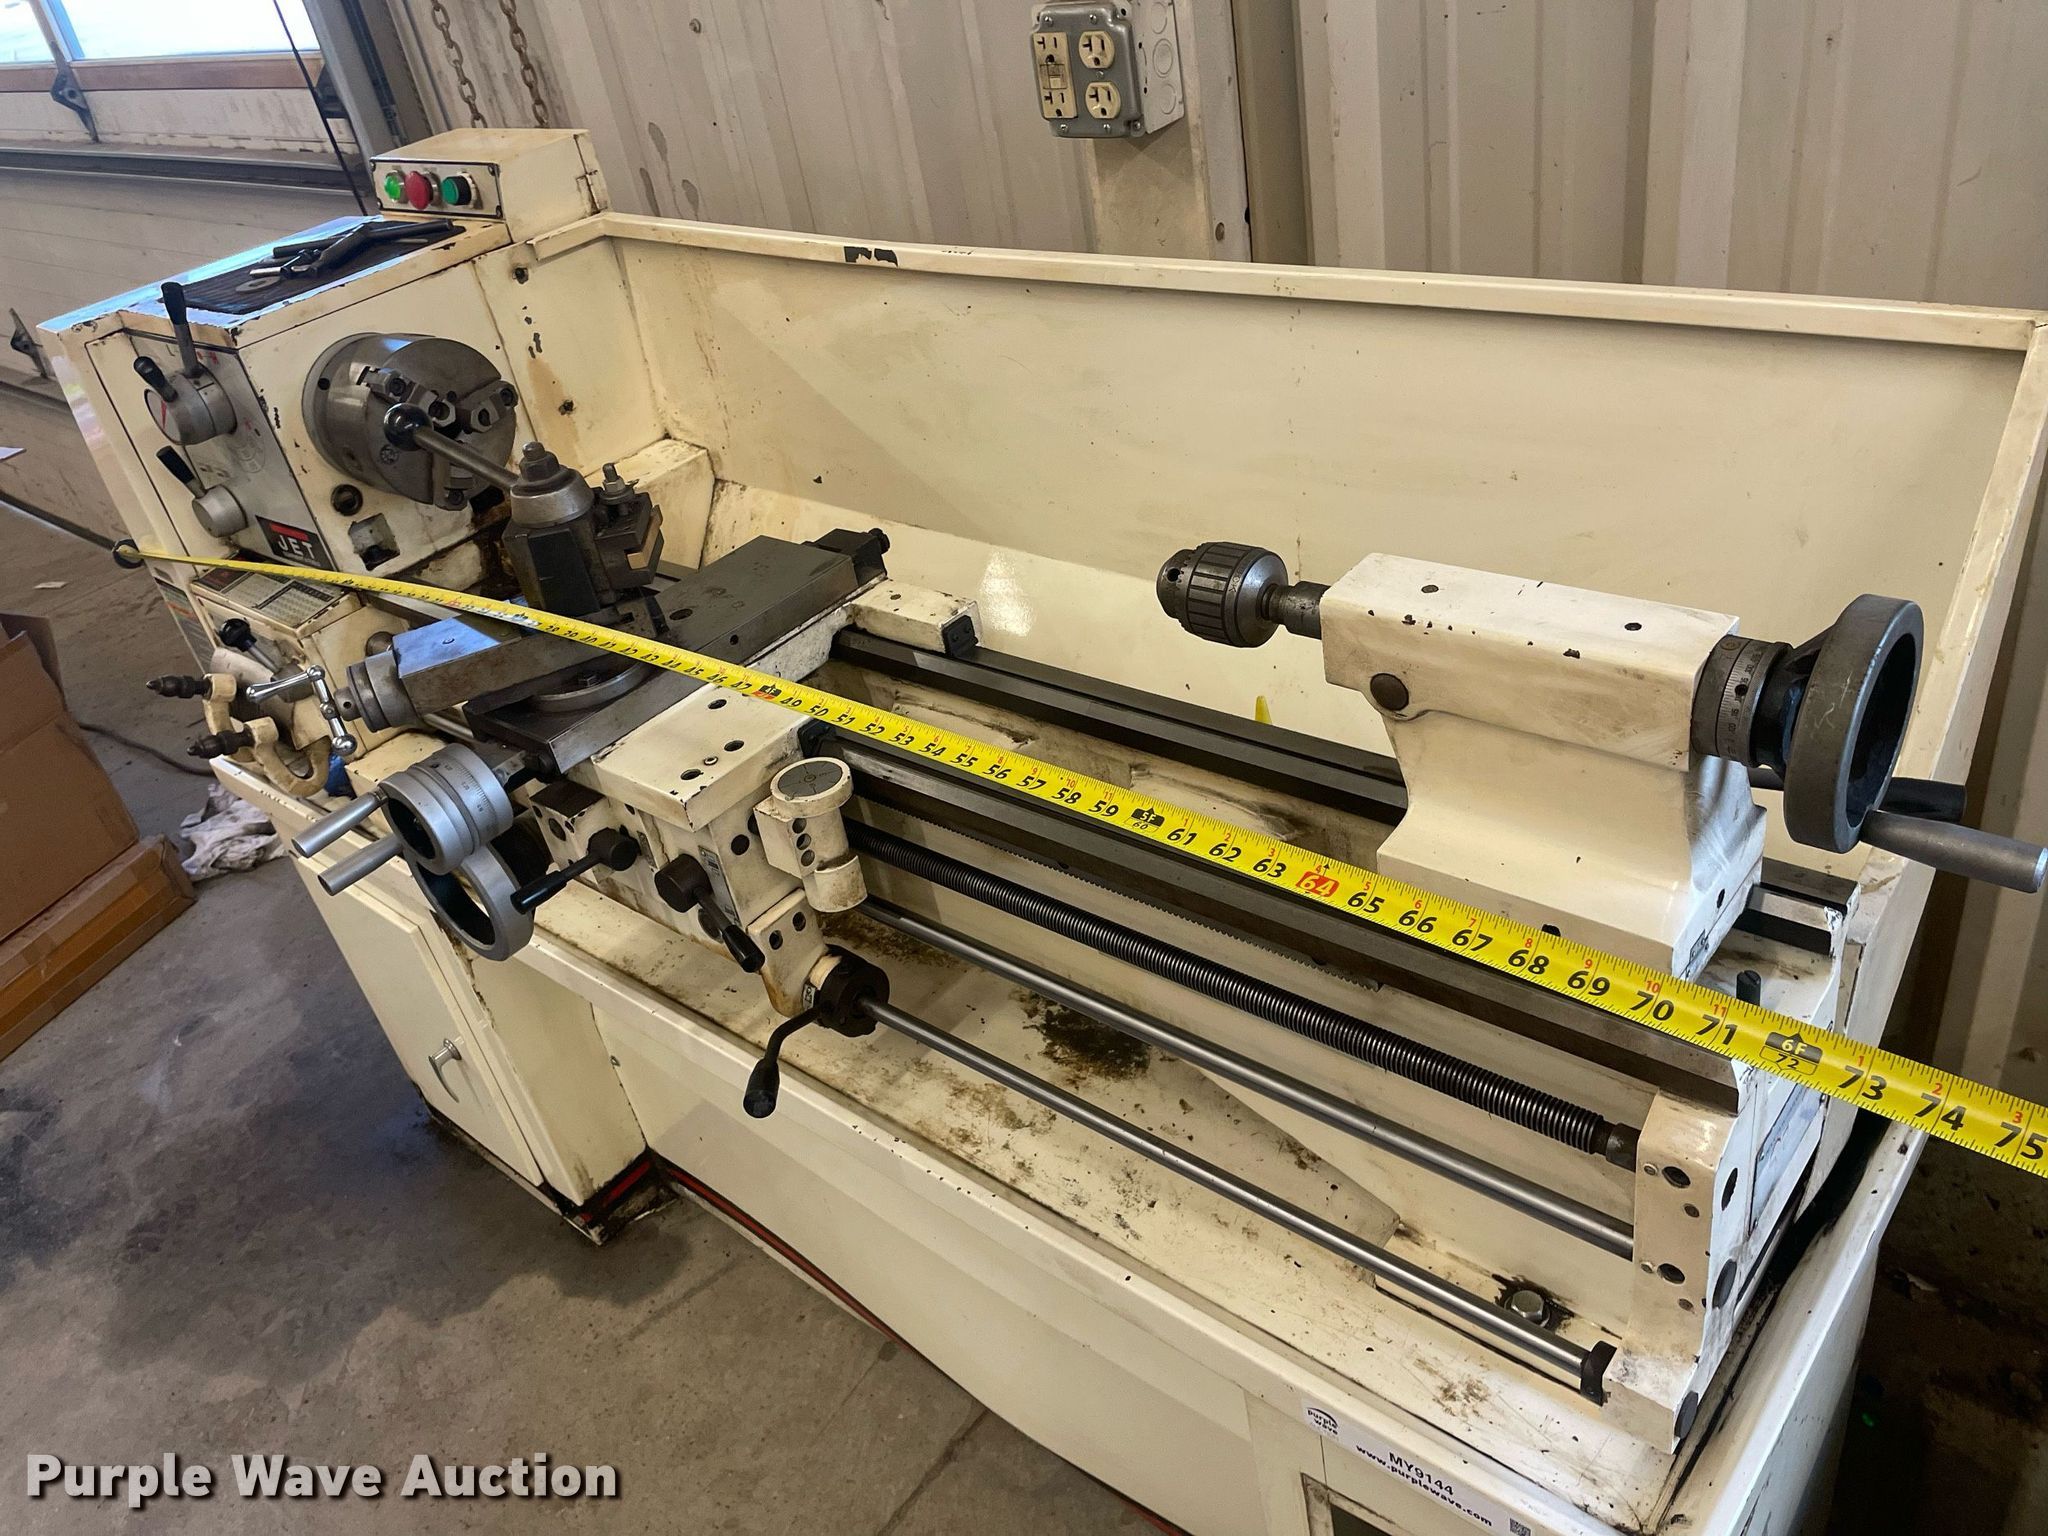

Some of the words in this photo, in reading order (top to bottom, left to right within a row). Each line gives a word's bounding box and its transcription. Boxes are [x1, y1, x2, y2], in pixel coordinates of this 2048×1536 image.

[278, 534, 315, 559] JET
[1139, 812, 1156, 822] 5F
[804, 705, 829, 716] 50
[831, 714, 856, 725] 51
[859, 722, 885, 735] 52
[888, 732, 915, 746] 53
[918, 743, 947, 757] 54
[950, 753, 978, 767] 55
[982, 764, 1012, 779] 56
[1016, 776, 1047, 790] 57
[1051, 788, 1082, 804] 58
[1088, 800, 1119, 817] 59
[1132, 821, 1148, 830] 60
[1167, 828, 1197, 846] 61
[1208, 842, 1242, 862] 62
[1253, 858, 1287, 878] 63
[1300, 875, 1334, 897] 64
[1347, 891, 1386, 913] 65
[1398, 909, 1437, 933] 66
[1452, 929, 1493, 952] 67
[1508, 949, 1550, 975] 68
[1567, 970, 1610, 996] 69
[1629, 990, 1675, 1021] 70
[1696, 1014, 1738, 1046] 71
[1776, 1053, 1800, 1069] 72
[1838, 1065, 1888, 1100] 73
[1915, 1093, 1965, 1131] 74
[1994, 1122, 2048, 1160] 75
[1066, 779, 1076, 788] 10
[1104, 790, 1113, 800] 11
[1224, 833, 1231, 842] 2
[1268, 848, 1275, 857] 3
[1364, 882, 1371, 891] 5
[1415, 900, 1422, 908] 6
[1468, 918, 1476, 928] 7
[1525, 938, 1532, 948] 8
[1584, 959, 1593, 969] 9
[1646, 980, 1661, 993] 10
[1713, 1004, 1727, 1017] 11
[1932, 1083, 1942, 1095] 2
[2013, 1111, 2023, 1124] 3
[1781, 1038, 1806, 1055] 6F
[1307, 1410, 1338, 1429] purple
[1313, 1418, 1338, 1435] wave
[1356, 1444, 1493, 1527] www.purplewave.com
[1388, 1451, 1454, 1496] MY9144
